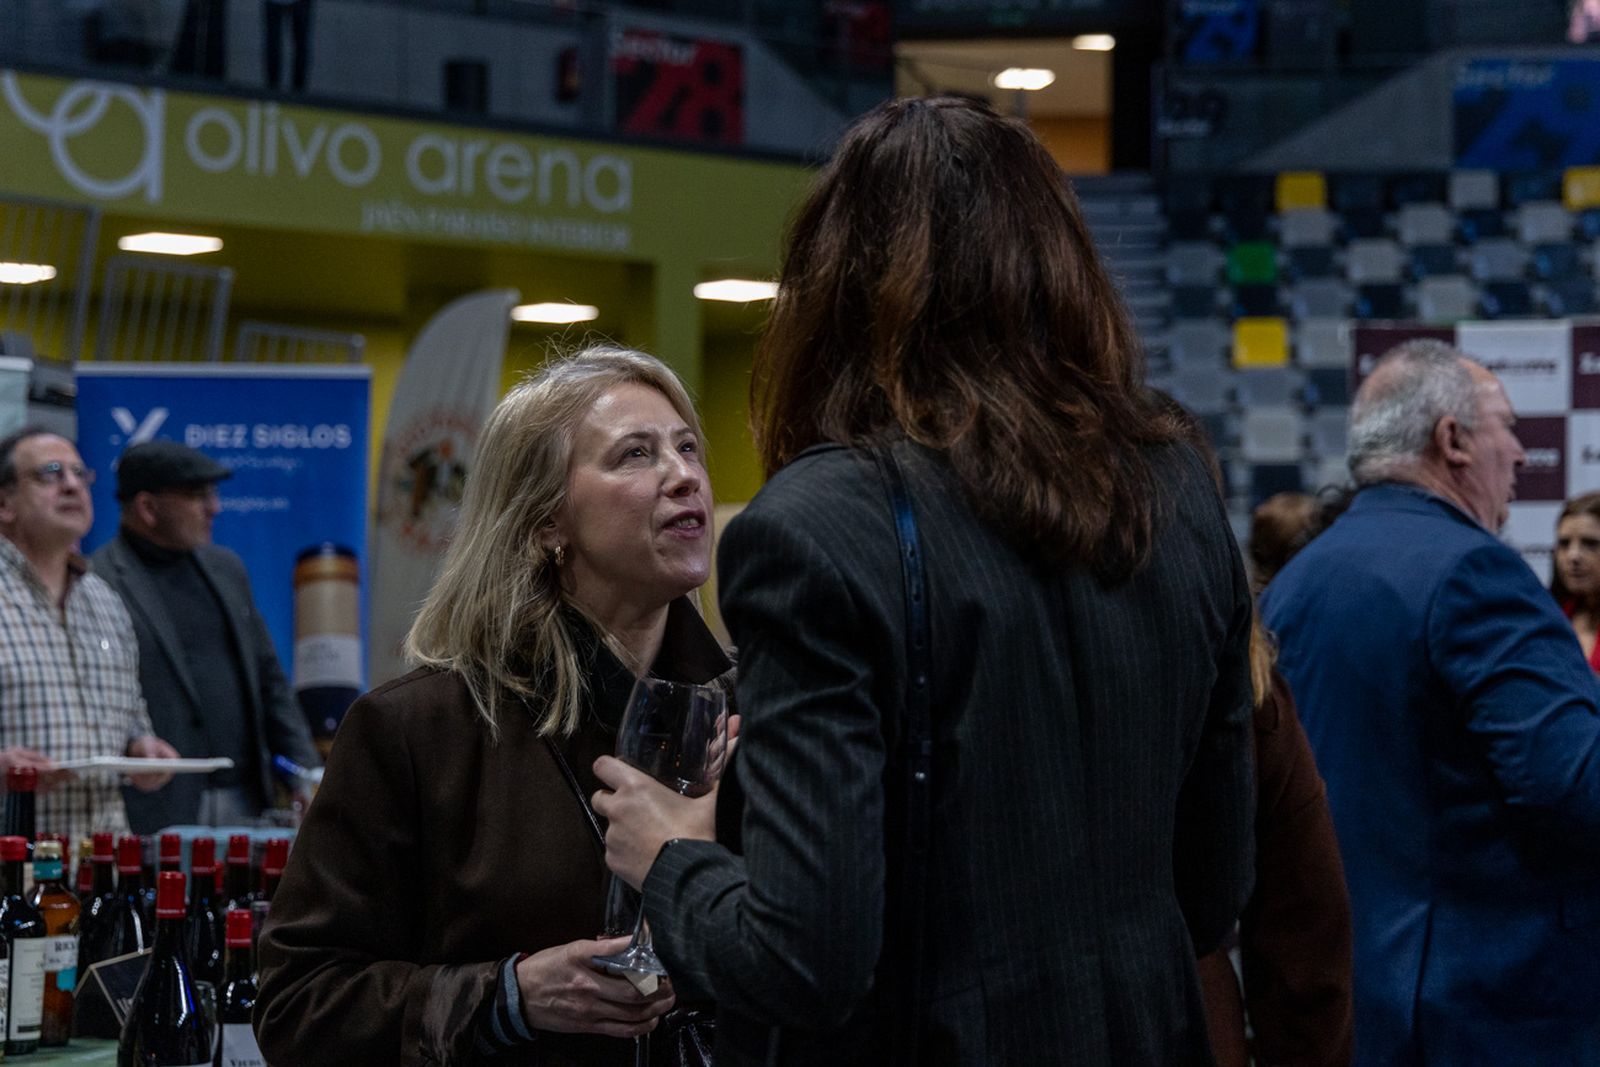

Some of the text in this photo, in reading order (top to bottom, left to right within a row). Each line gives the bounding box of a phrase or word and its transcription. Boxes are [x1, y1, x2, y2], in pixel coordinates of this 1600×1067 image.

[185, 102, 634, 214] olivo arena
[184, 423, 248, 449] DIEZ
[252, 423, 353, 450] SIGLOS
